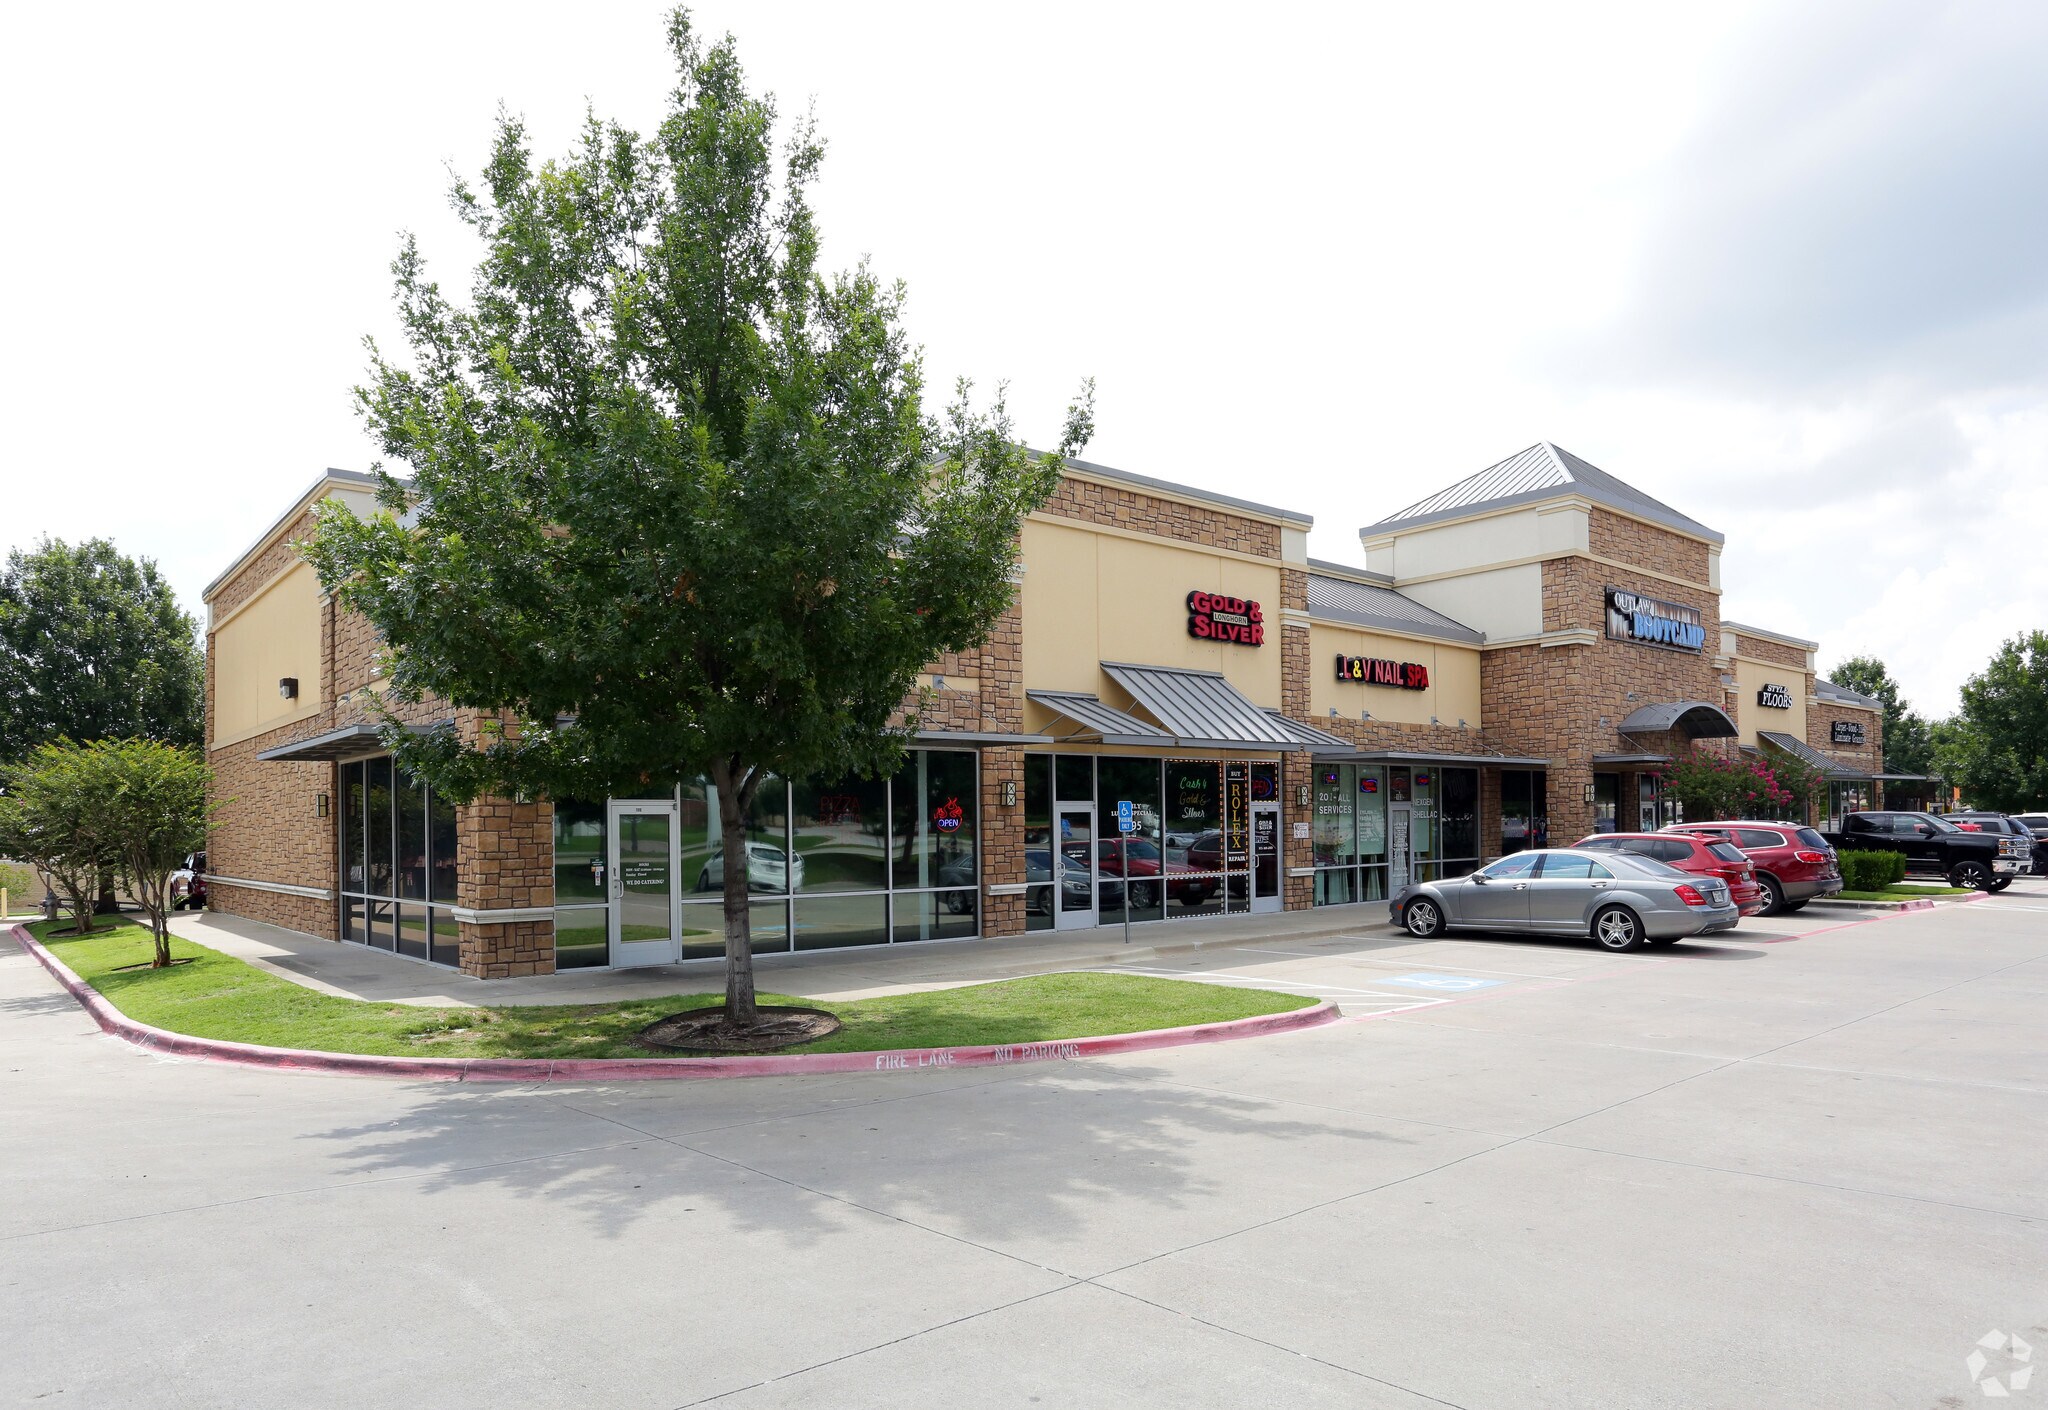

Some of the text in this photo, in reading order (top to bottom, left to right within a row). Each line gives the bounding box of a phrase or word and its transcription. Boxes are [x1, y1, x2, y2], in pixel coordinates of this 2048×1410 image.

[1193, 591, 1263, 623] GOLD &
[1614, 592, 1652, 617] OUTLAW
[1213, 612, 1248, 625] LONGHORN
[1194, 615, 1265, 645] SILVER
[1633, 612, 1705, 648] BOOTCAMP
[1375, 659, 1404, 685] NAIL
[1407, 664, 1429, 687] SPA
[1767, 684, 1789, 694] STYLE
[1762, 692, 1793, 708] FLOORS
[1180, 776, 1200, 789] Cash
[1179, 792, 1198, 805] Gold
[1182, 806, 1205, 819] Silver
[1231, 784, 1241, 849] ROLEX
[1319, 805, 1352, 814] SERVICES
[1413, 810, 1438, 819] SHELLAC
[938, 818, 959, 827] OPEN
[875, 1043, 1081, 1071] FIRE LANE NO PARKING
